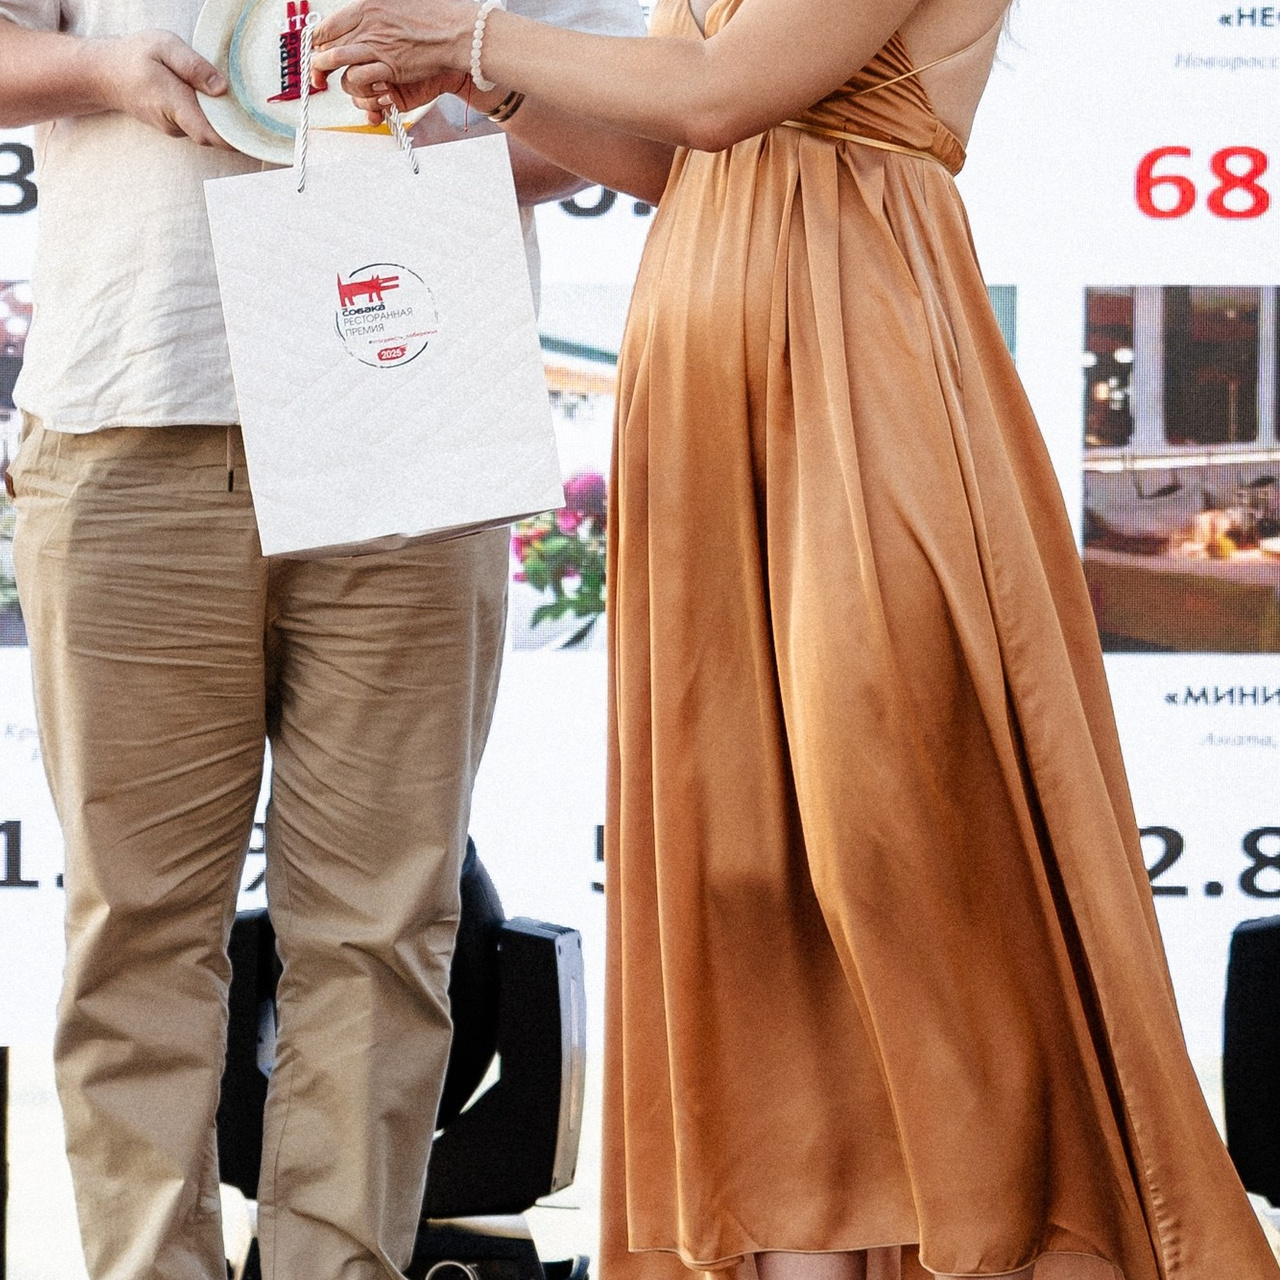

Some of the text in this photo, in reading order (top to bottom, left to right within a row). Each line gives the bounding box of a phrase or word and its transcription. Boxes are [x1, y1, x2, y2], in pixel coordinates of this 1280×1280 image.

[343, 307, 413, 327] РЕСТОРАННАЯ
[345, 323, 385, 337] ПРЕМИЯ
[381, 349, 402, 360] 2025
